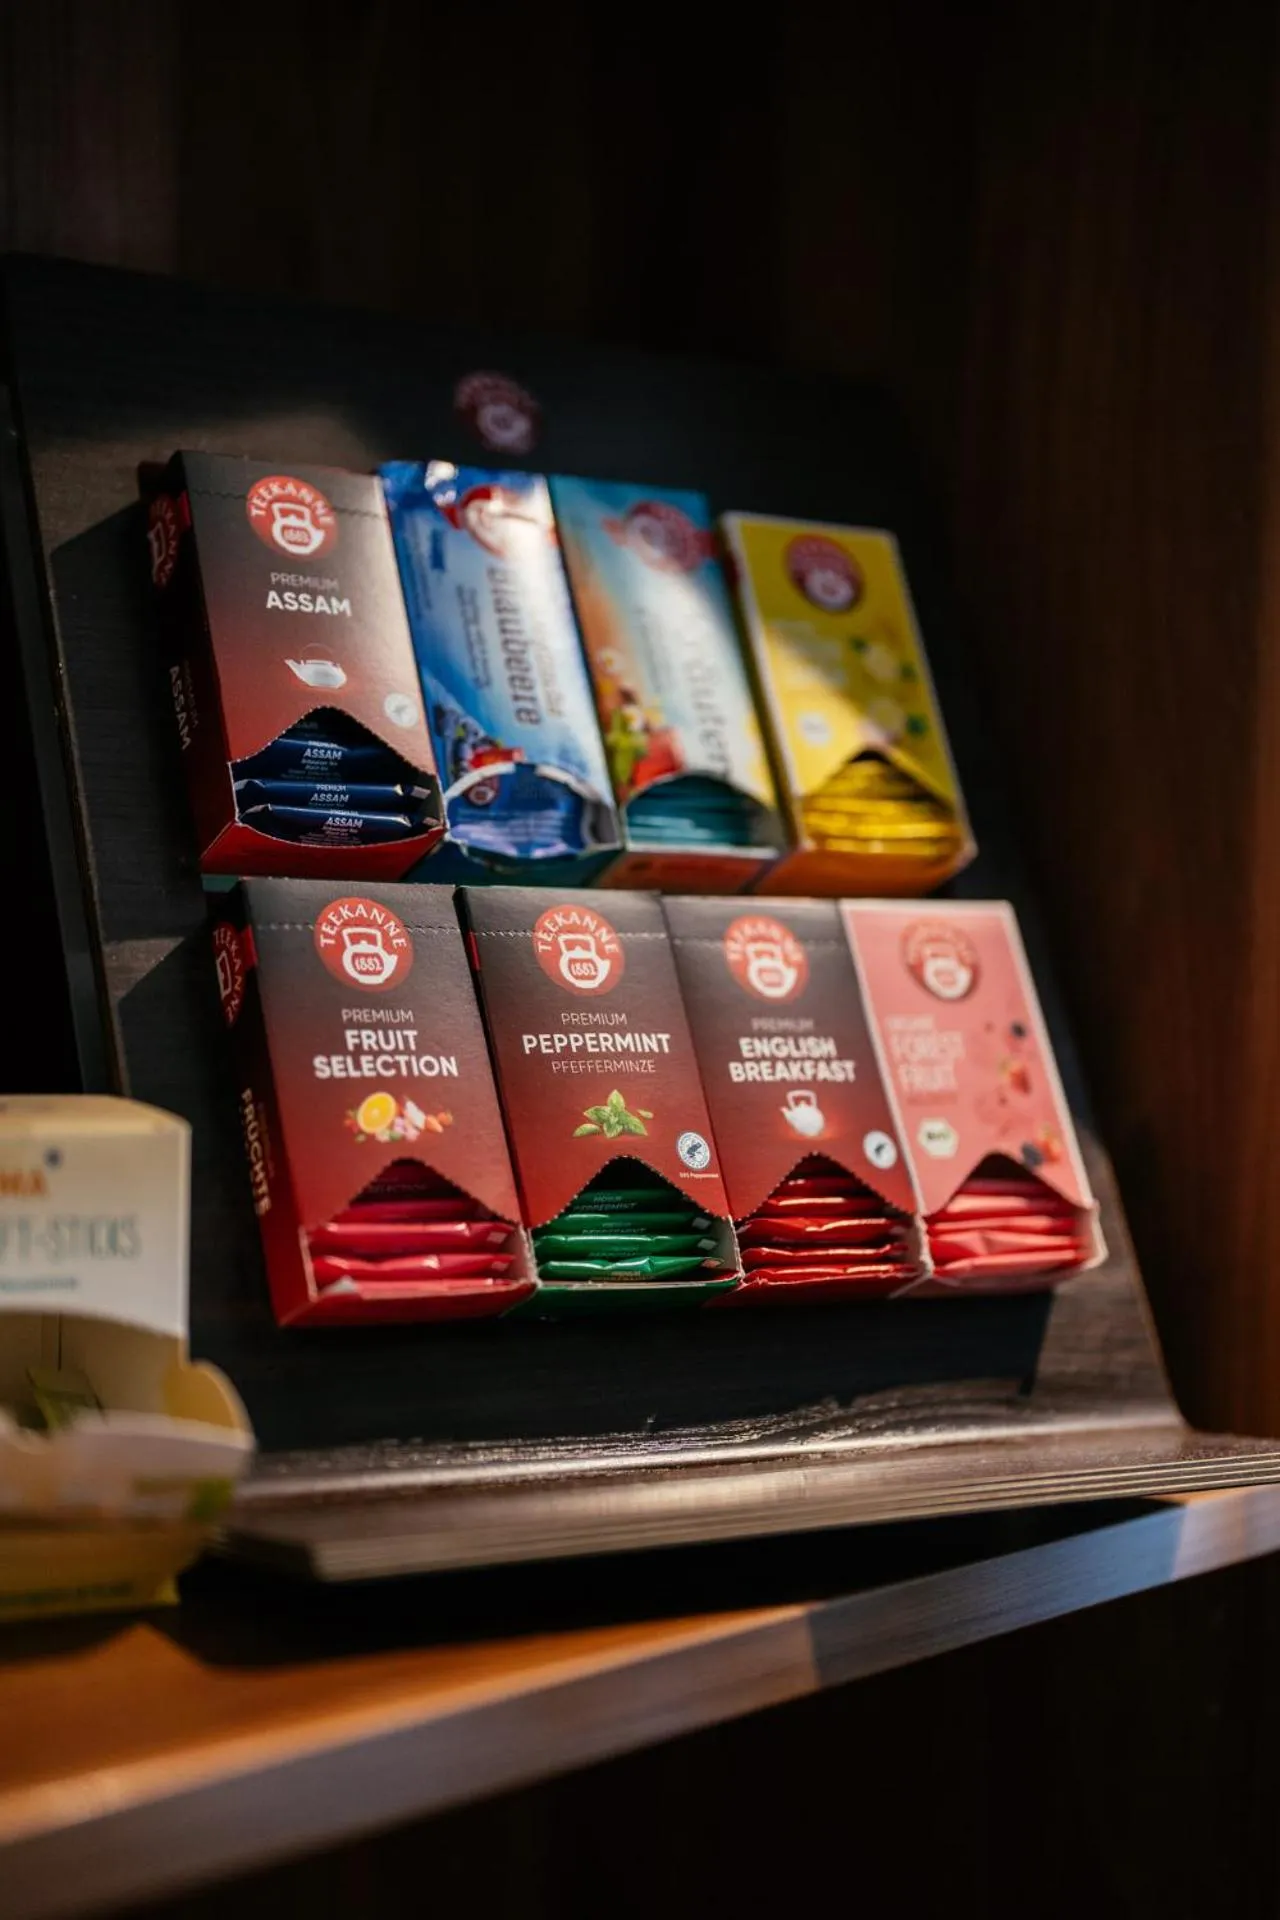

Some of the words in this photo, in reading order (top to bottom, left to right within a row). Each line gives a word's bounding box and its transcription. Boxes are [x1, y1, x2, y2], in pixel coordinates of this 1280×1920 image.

[269, 572, 340, 591] PREMIUM
[265, 590, 353, 617] ASSAM
[169, 664, 192, 751] ASSAM
[303, 748, 343, 760] ASSAM
[310, 792, 349, 803] ASSAM
[324, 816, 364, 829] ASSAM
[320, 903, 407, 950] TEEKANNE
[537, 911, 619, 954] TEEKANNE
[341, 1008, 415, 1024] PREMIUM
[561, 1012, 628, 1026] PREMIUM
[344, 1029, 419, 1051] FRUIT
[522, 1032, 672, 1055] PEPPERMINT
[739, 1036, 838, 1059] ENGLISH
[312, 1055, 460, 1079] SELECTION
[551, 1059, 657, 1075] PFEFFERMINZE
[728, 1058, 857, 1083] BREAKFAST
